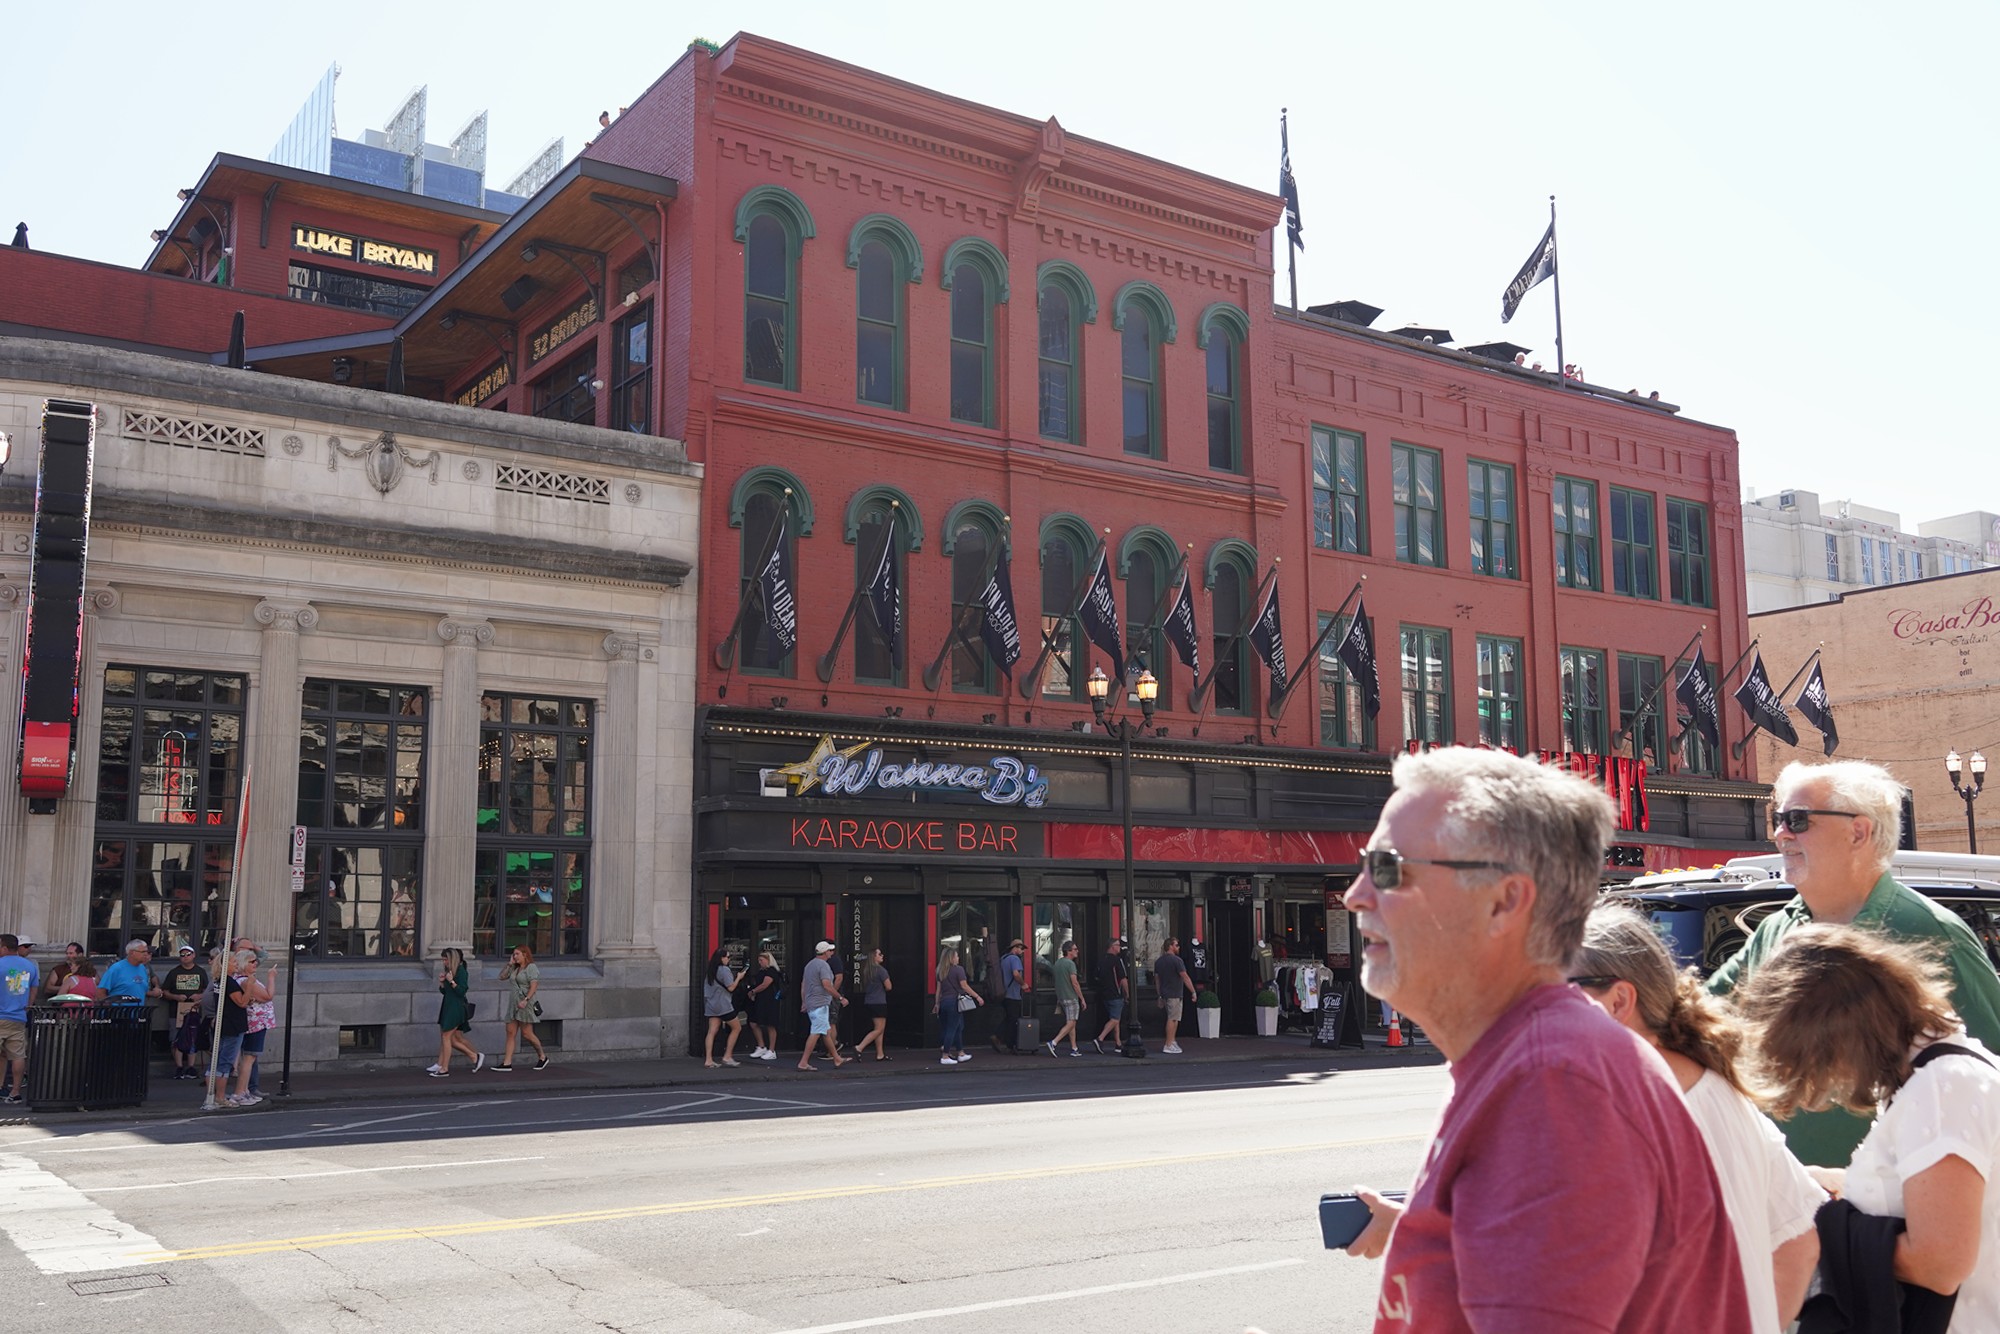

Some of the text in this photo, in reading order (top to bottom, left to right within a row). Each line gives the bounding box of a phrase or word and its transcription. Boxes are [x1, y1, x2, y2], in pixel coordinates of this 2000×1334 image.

[296, 228, 434, 272] LUKE BRYAN
[532, 299, 597, 361] 32 BRIDGE
[457, 384, 478, 407] UKE
[776, 629, 793, 650] BAR
[1887, 609, 1960, 639] Casa
[817, 748, 1048, 809] Wanna B's
[791, 817, 1018, 852] KARAOKE BAR
